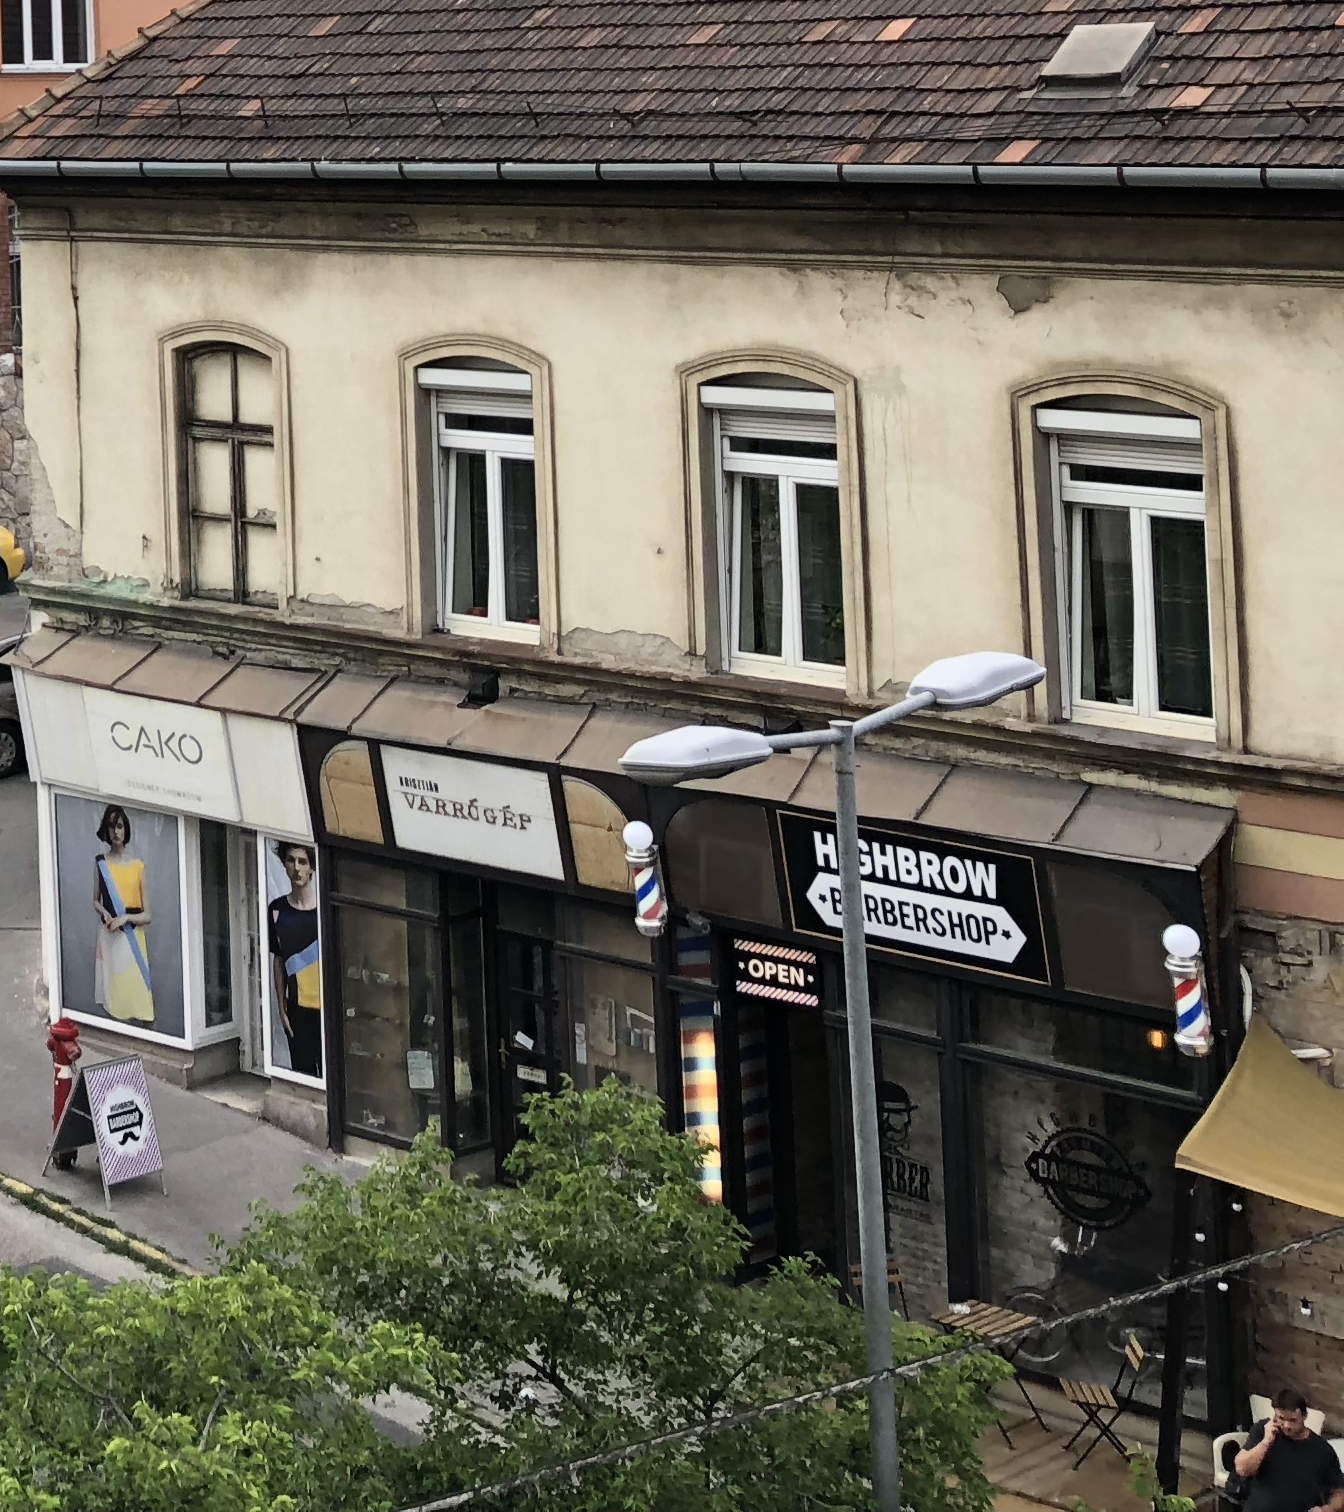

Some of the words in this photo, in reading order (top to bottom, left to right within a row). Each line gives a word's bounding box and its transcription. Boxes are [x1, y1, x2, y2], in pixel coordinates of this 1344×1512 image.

[110, 720, 203, 765] CAKO
[401, 791, 533, 831] VARRÓGÉP
[813, 830, 998, 900] HGHBROW
[829, 886, 998, 946] BRBERSHOP
[747, 958, 806, 987] OPEN
